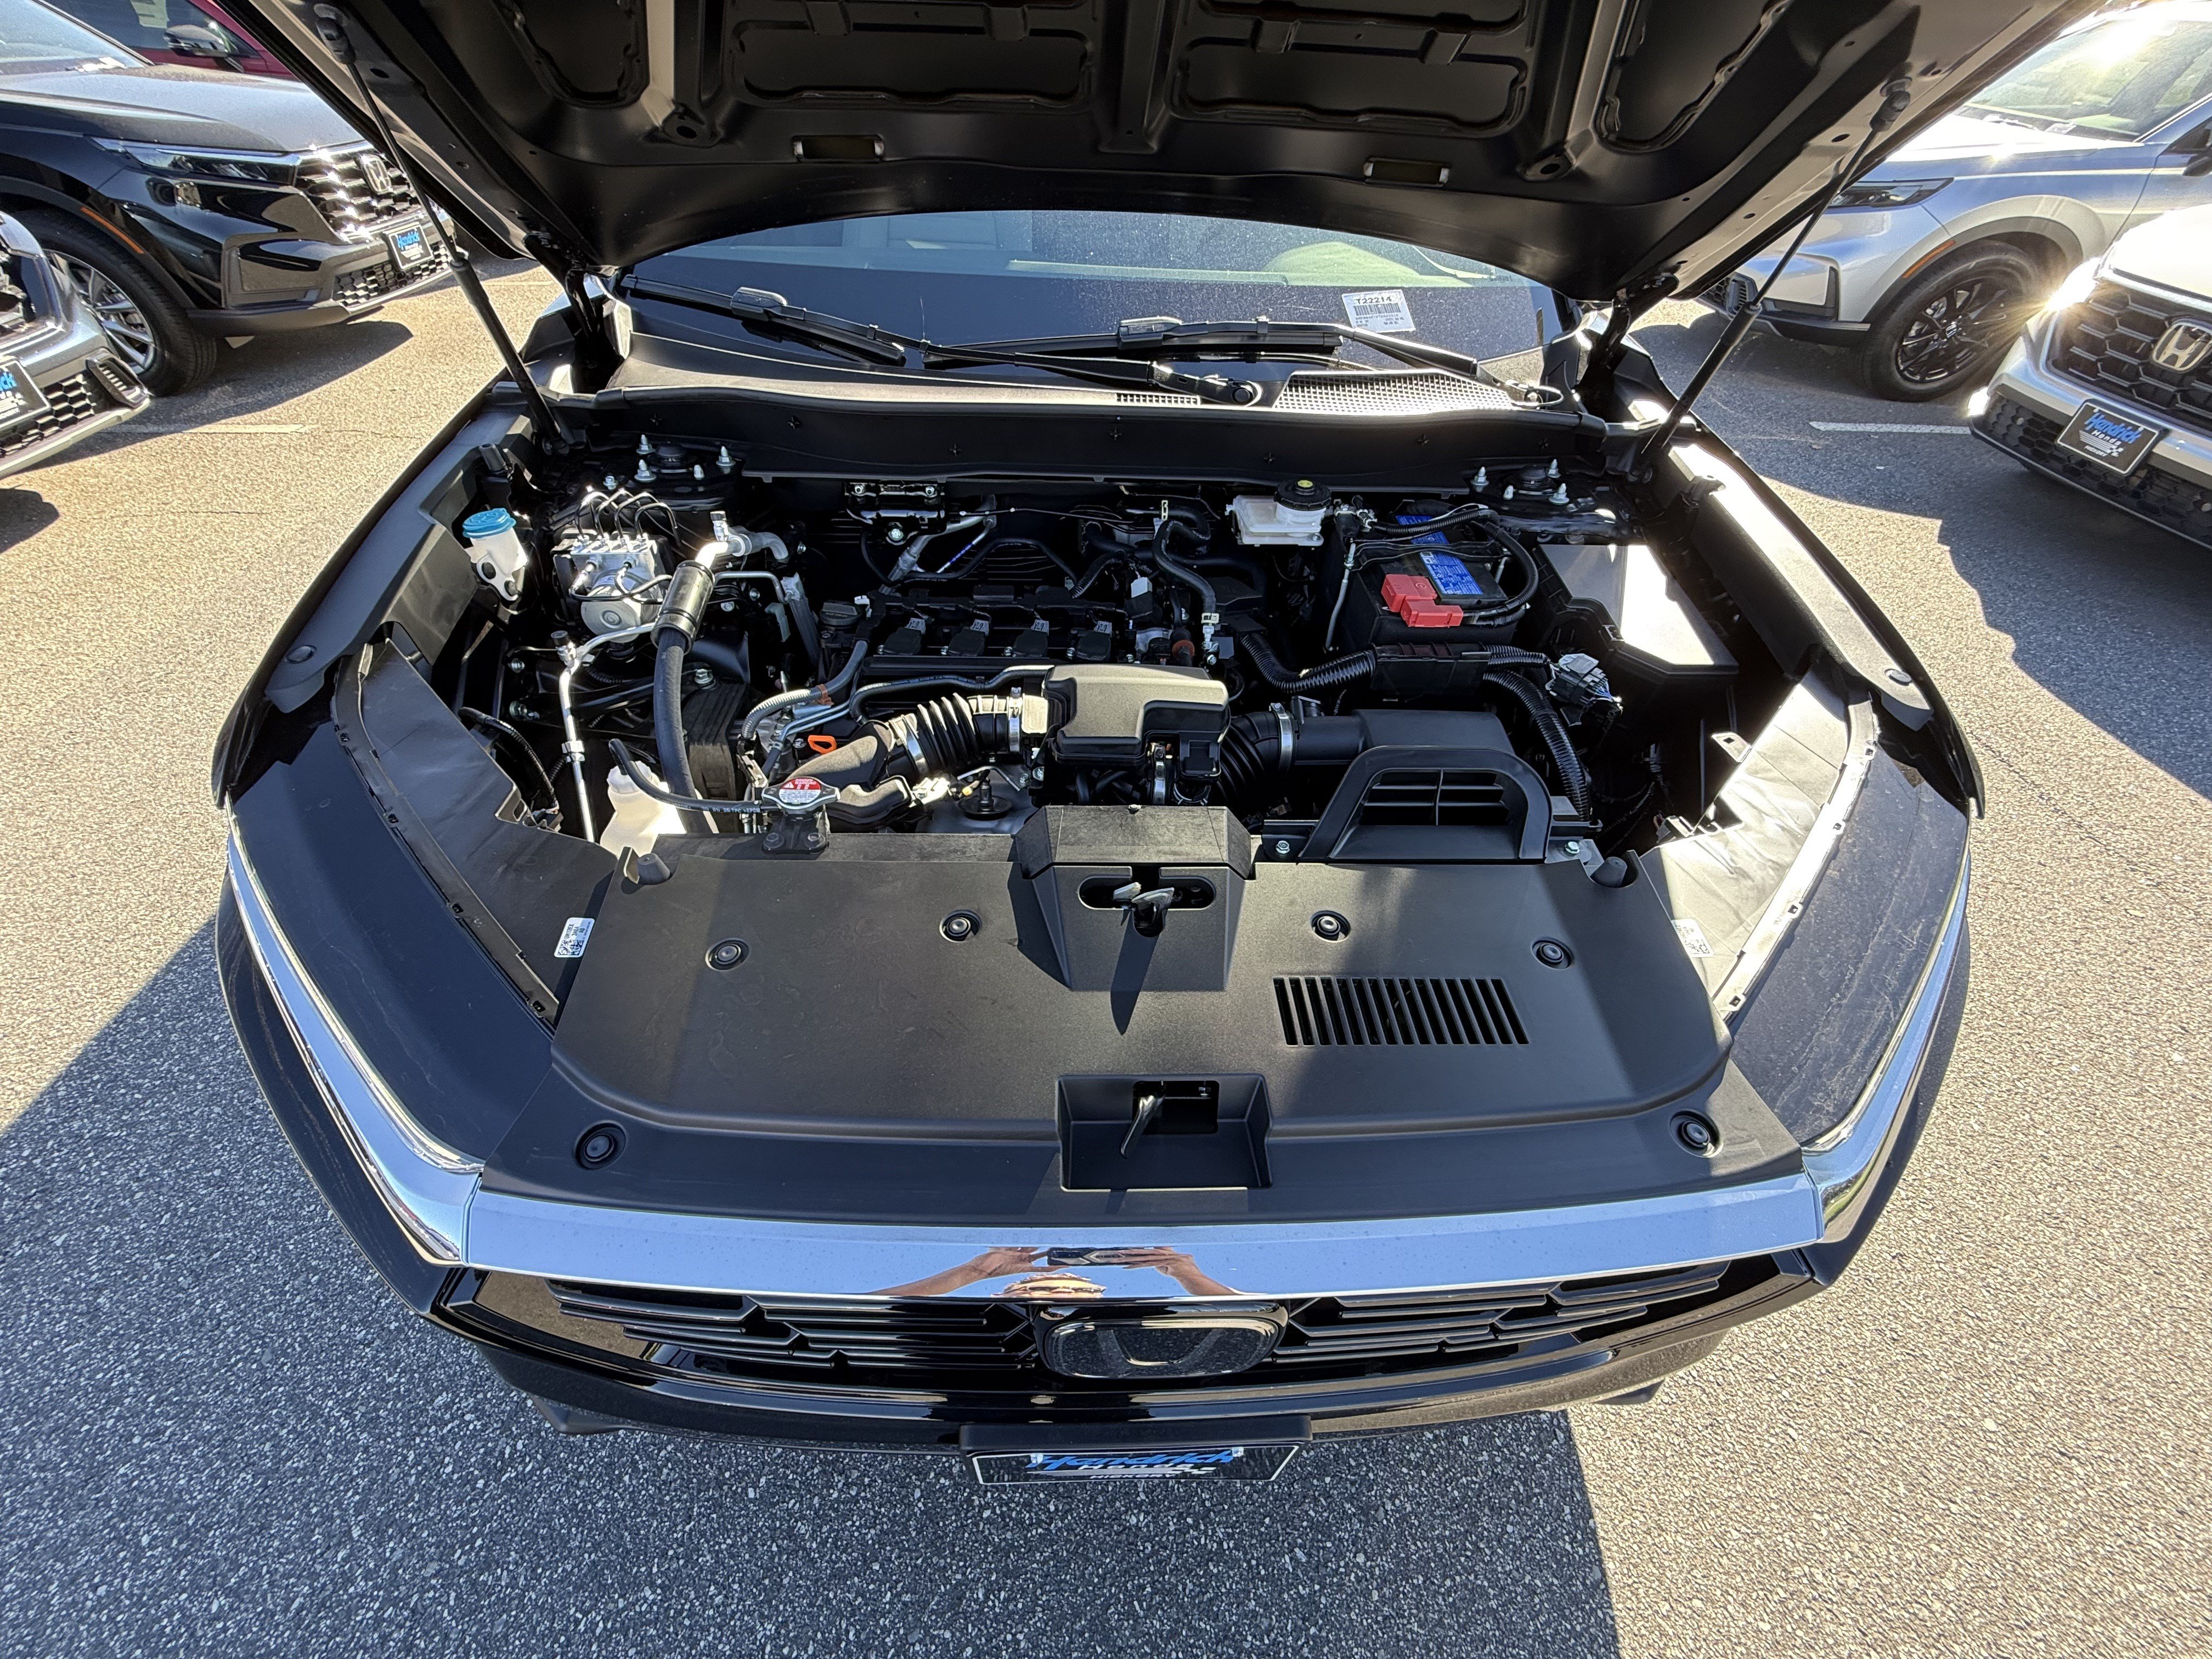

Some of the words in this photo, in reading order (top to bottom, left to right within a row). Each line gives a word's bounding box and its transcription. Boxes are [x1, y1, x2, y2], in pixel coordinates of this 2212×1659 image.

[2084, 412, 2142, 444] Hendrick
[2091, 430, 2121, 445] Honda
[1025, 1451, 1234, 1471] Hendrick
